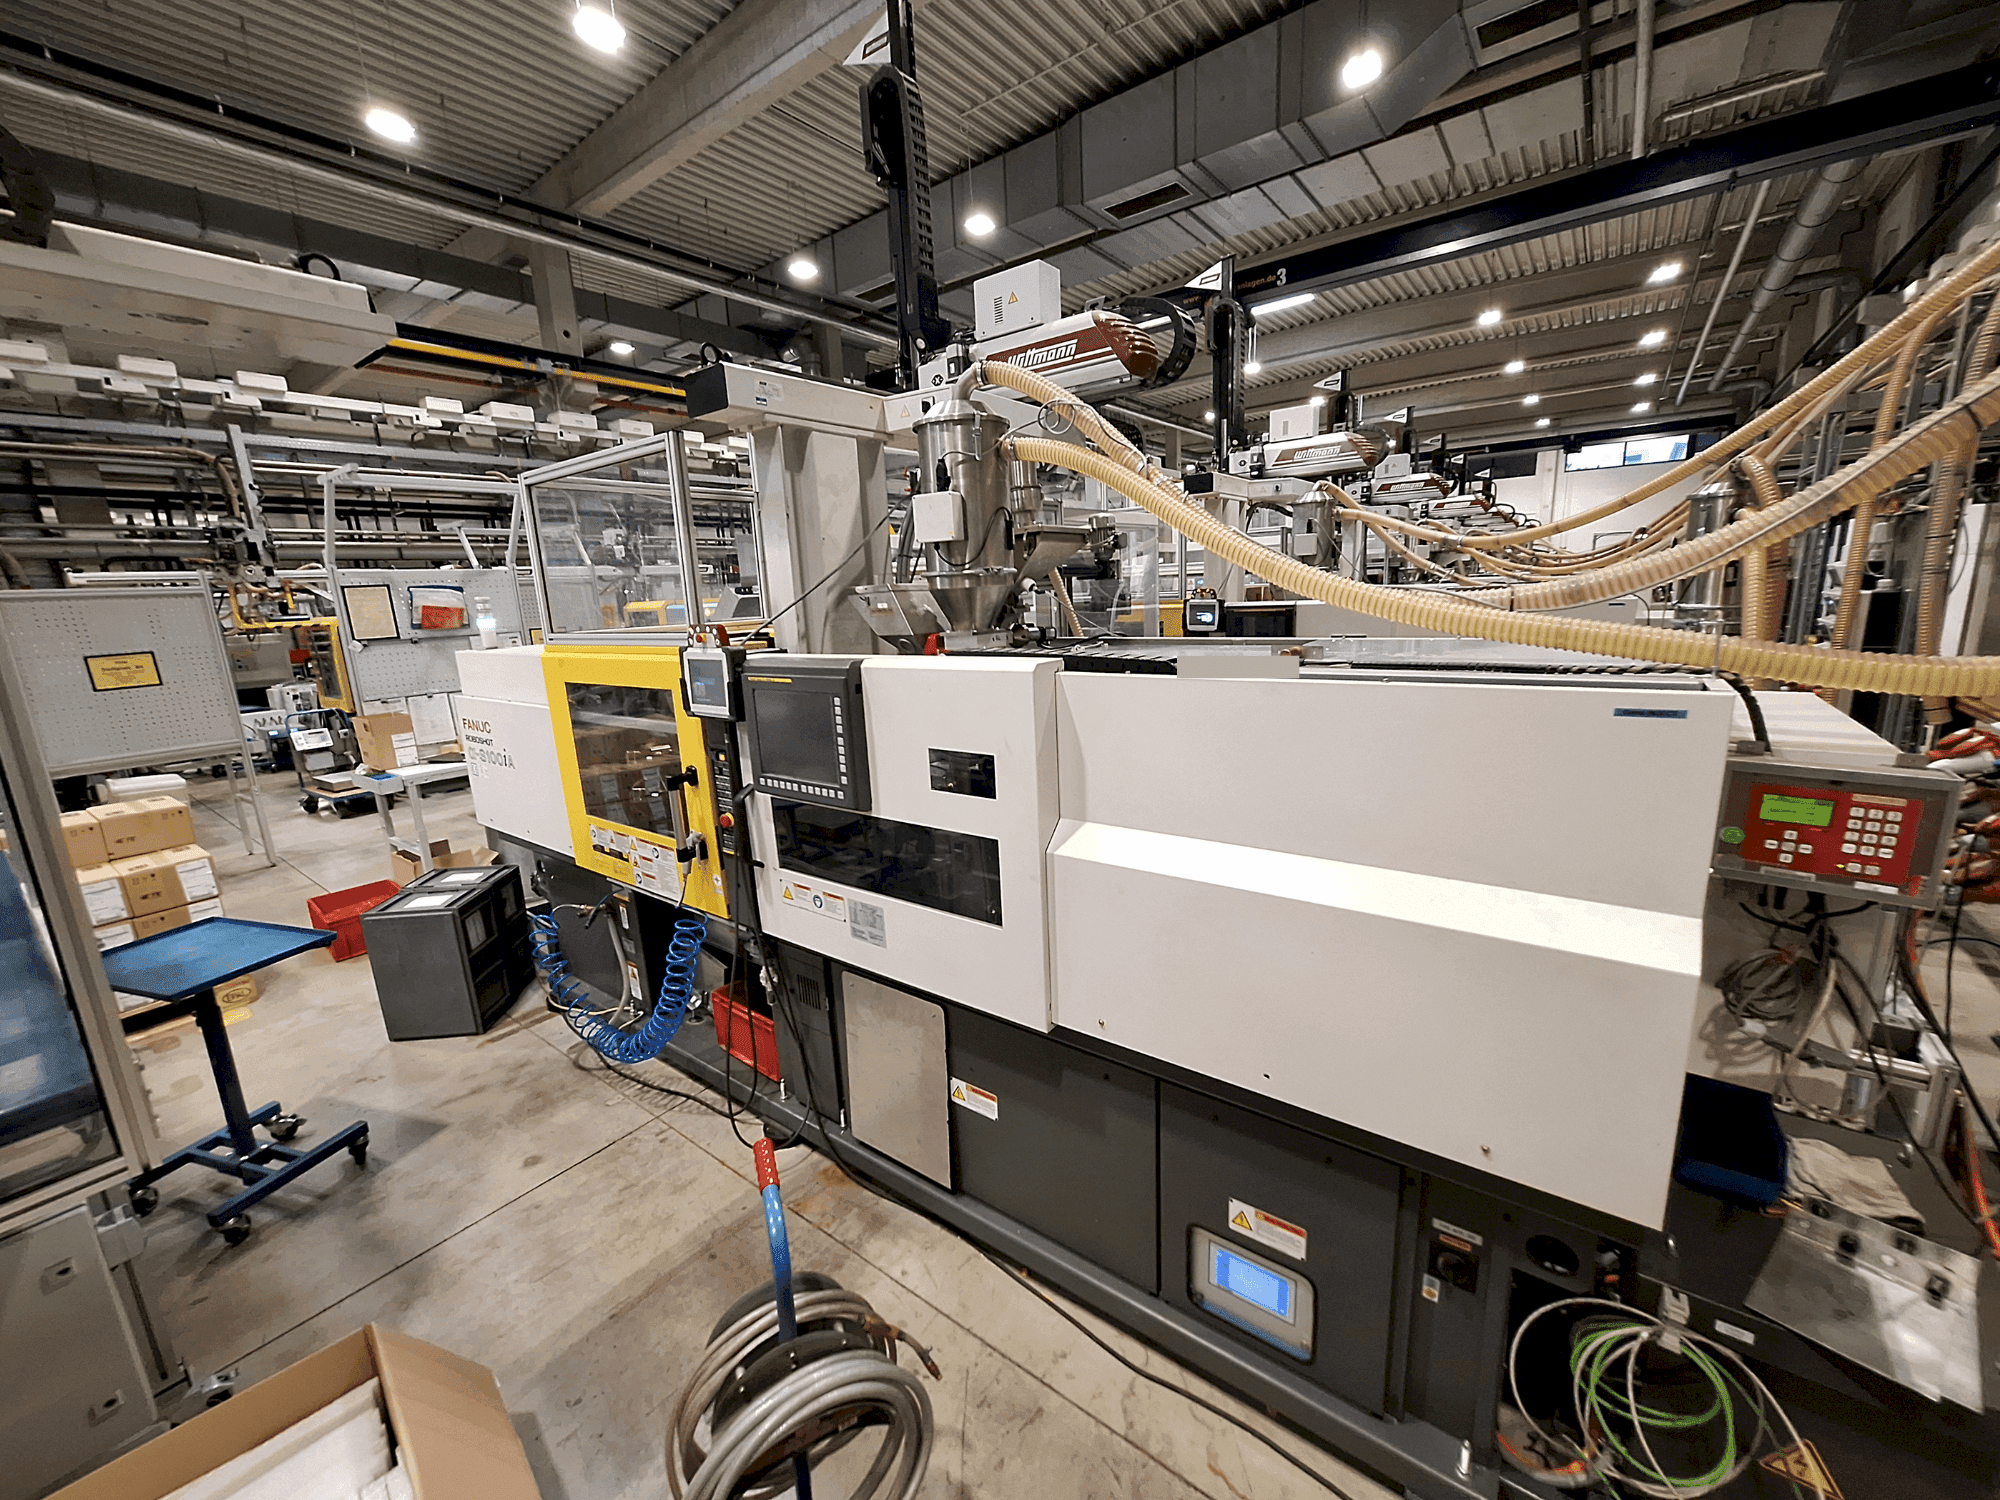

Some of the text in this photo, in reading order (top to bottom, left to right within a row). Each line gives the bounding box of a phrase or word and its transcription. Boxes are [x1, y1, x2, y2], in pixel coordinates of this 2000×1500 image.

[1276, 267, 1287, 287] 3
[462, 718, 491, 734] FANUC
[465, 734, 493, 747] ROBOSHOT
